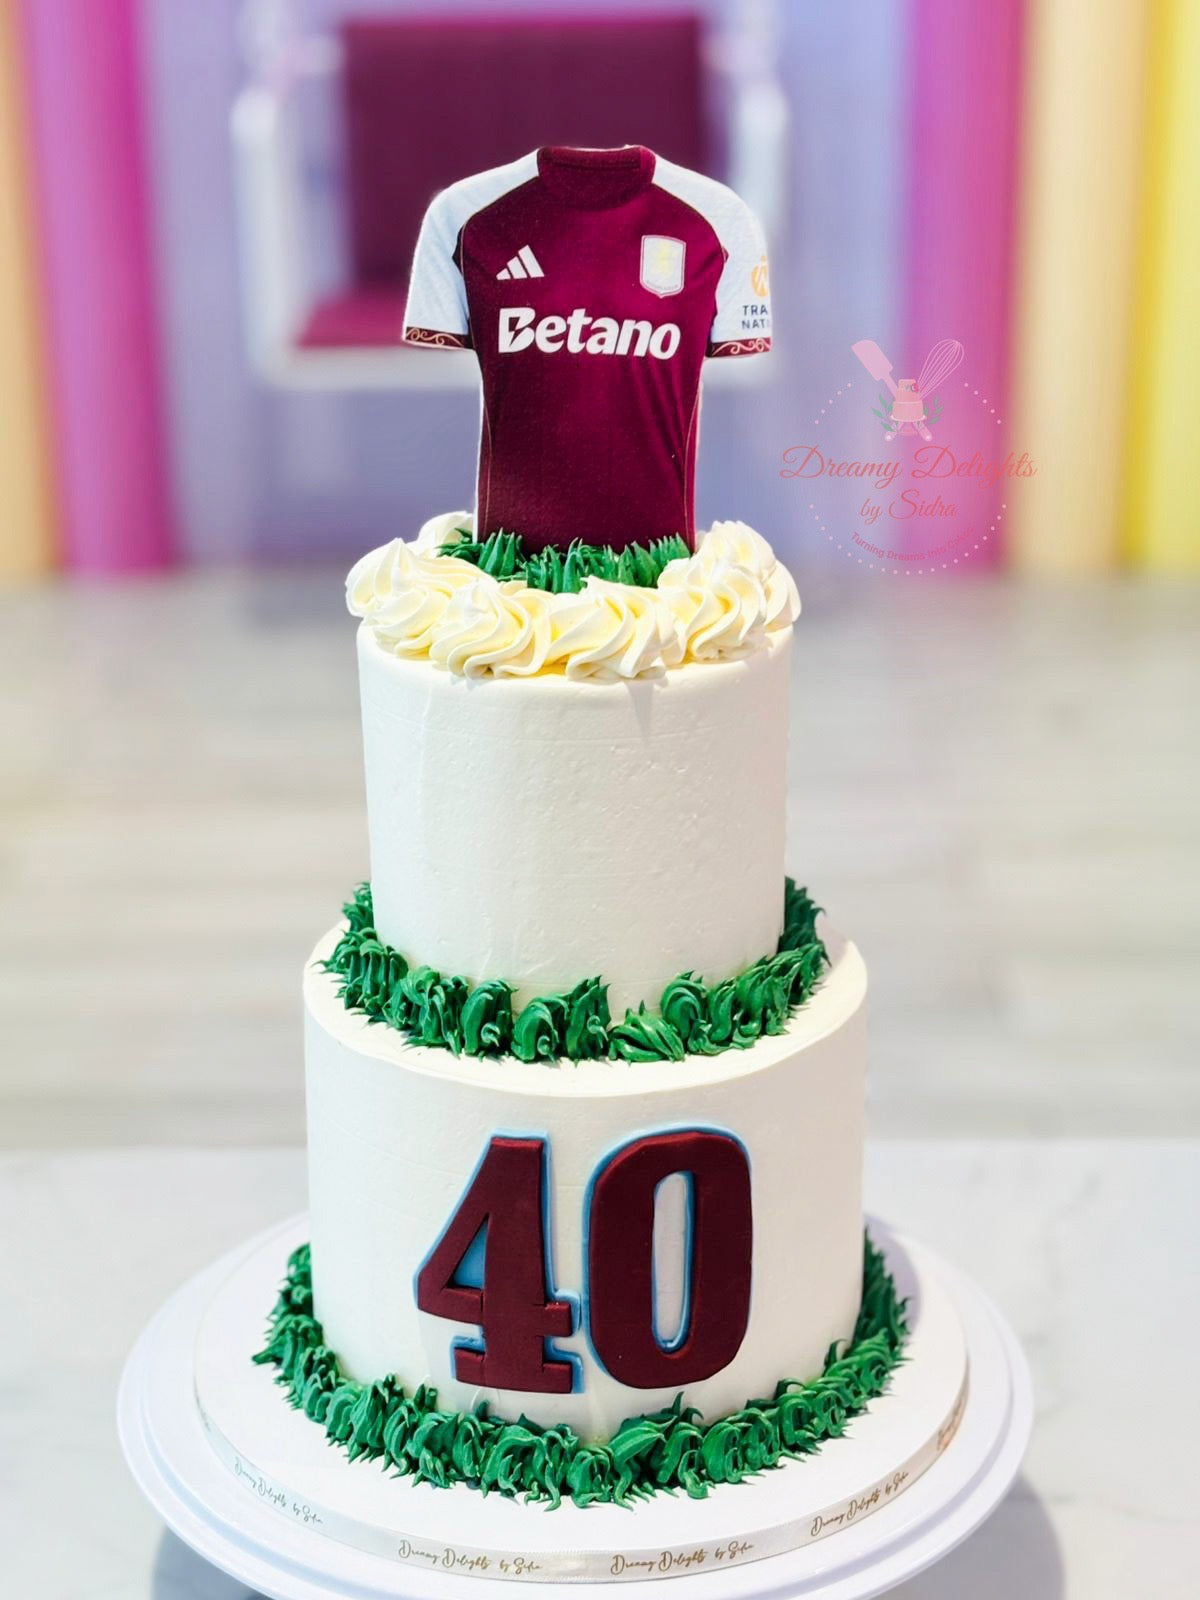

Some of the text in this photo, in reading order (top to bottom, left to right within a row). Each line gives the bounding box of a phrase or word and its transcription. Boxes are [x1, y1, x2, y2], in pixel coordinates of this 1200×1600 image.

[498, 307, 681, 360] Betano
[742, 304, 768, 316] TRA
[412, 1121, 753, 1394] 40
